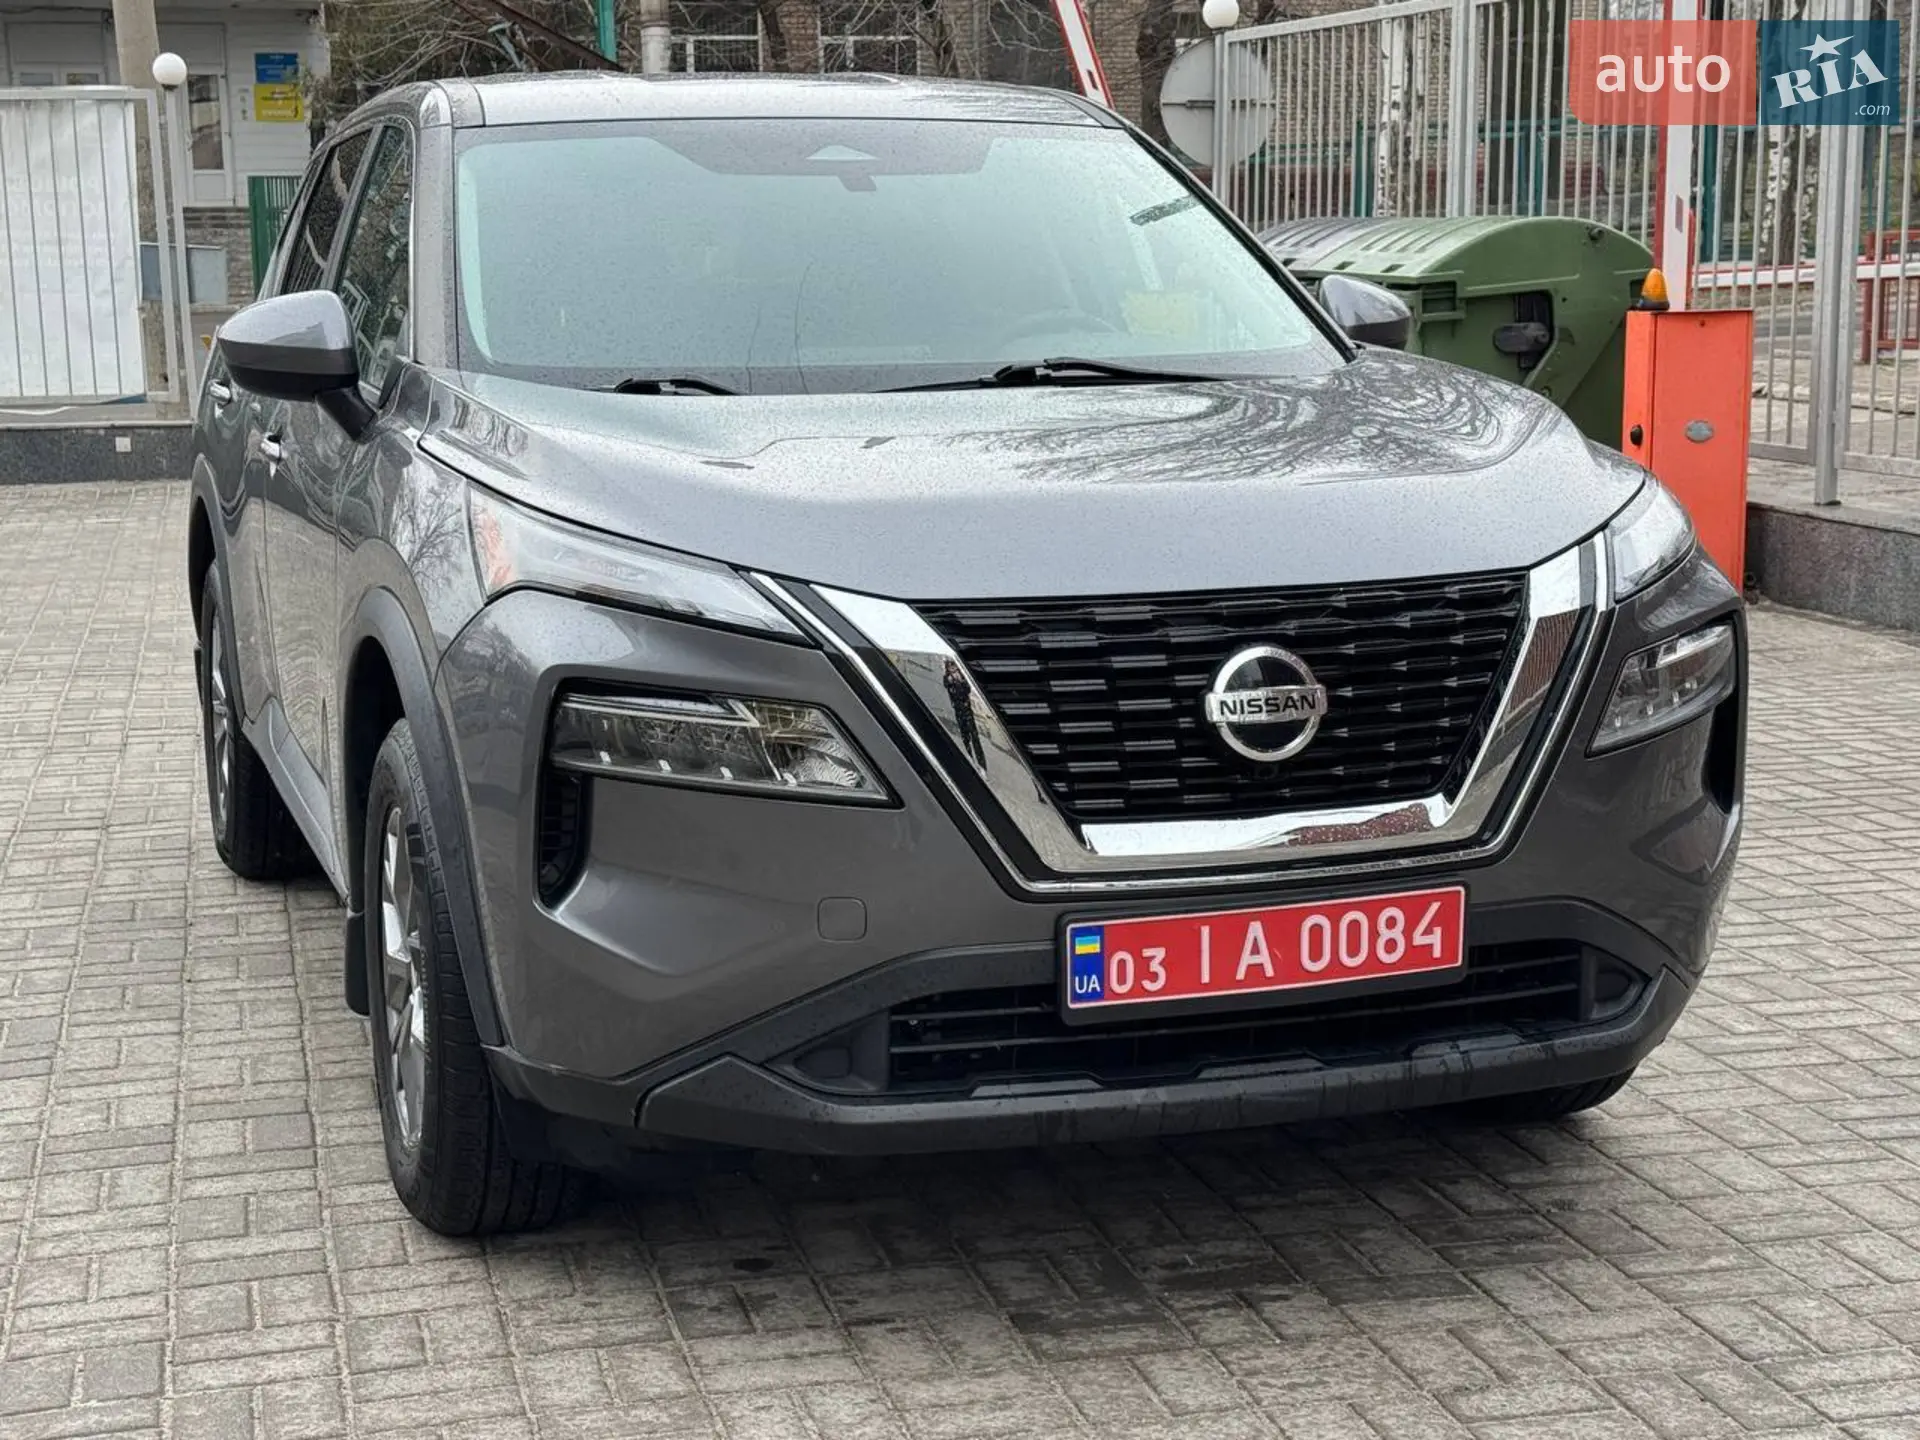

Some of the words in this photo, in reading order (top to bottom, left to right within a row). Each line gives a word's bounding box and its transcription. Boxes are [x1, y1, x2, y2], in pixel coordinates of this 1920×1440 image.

[1219, 694, 1316, 716] NISSAN
[1109, 947, 1167, 995] 03
[1200, 920, 1275, 985] IA
[1300, 901, 1442, 973] 0084
[1074, 974, 1101, 994] UA
